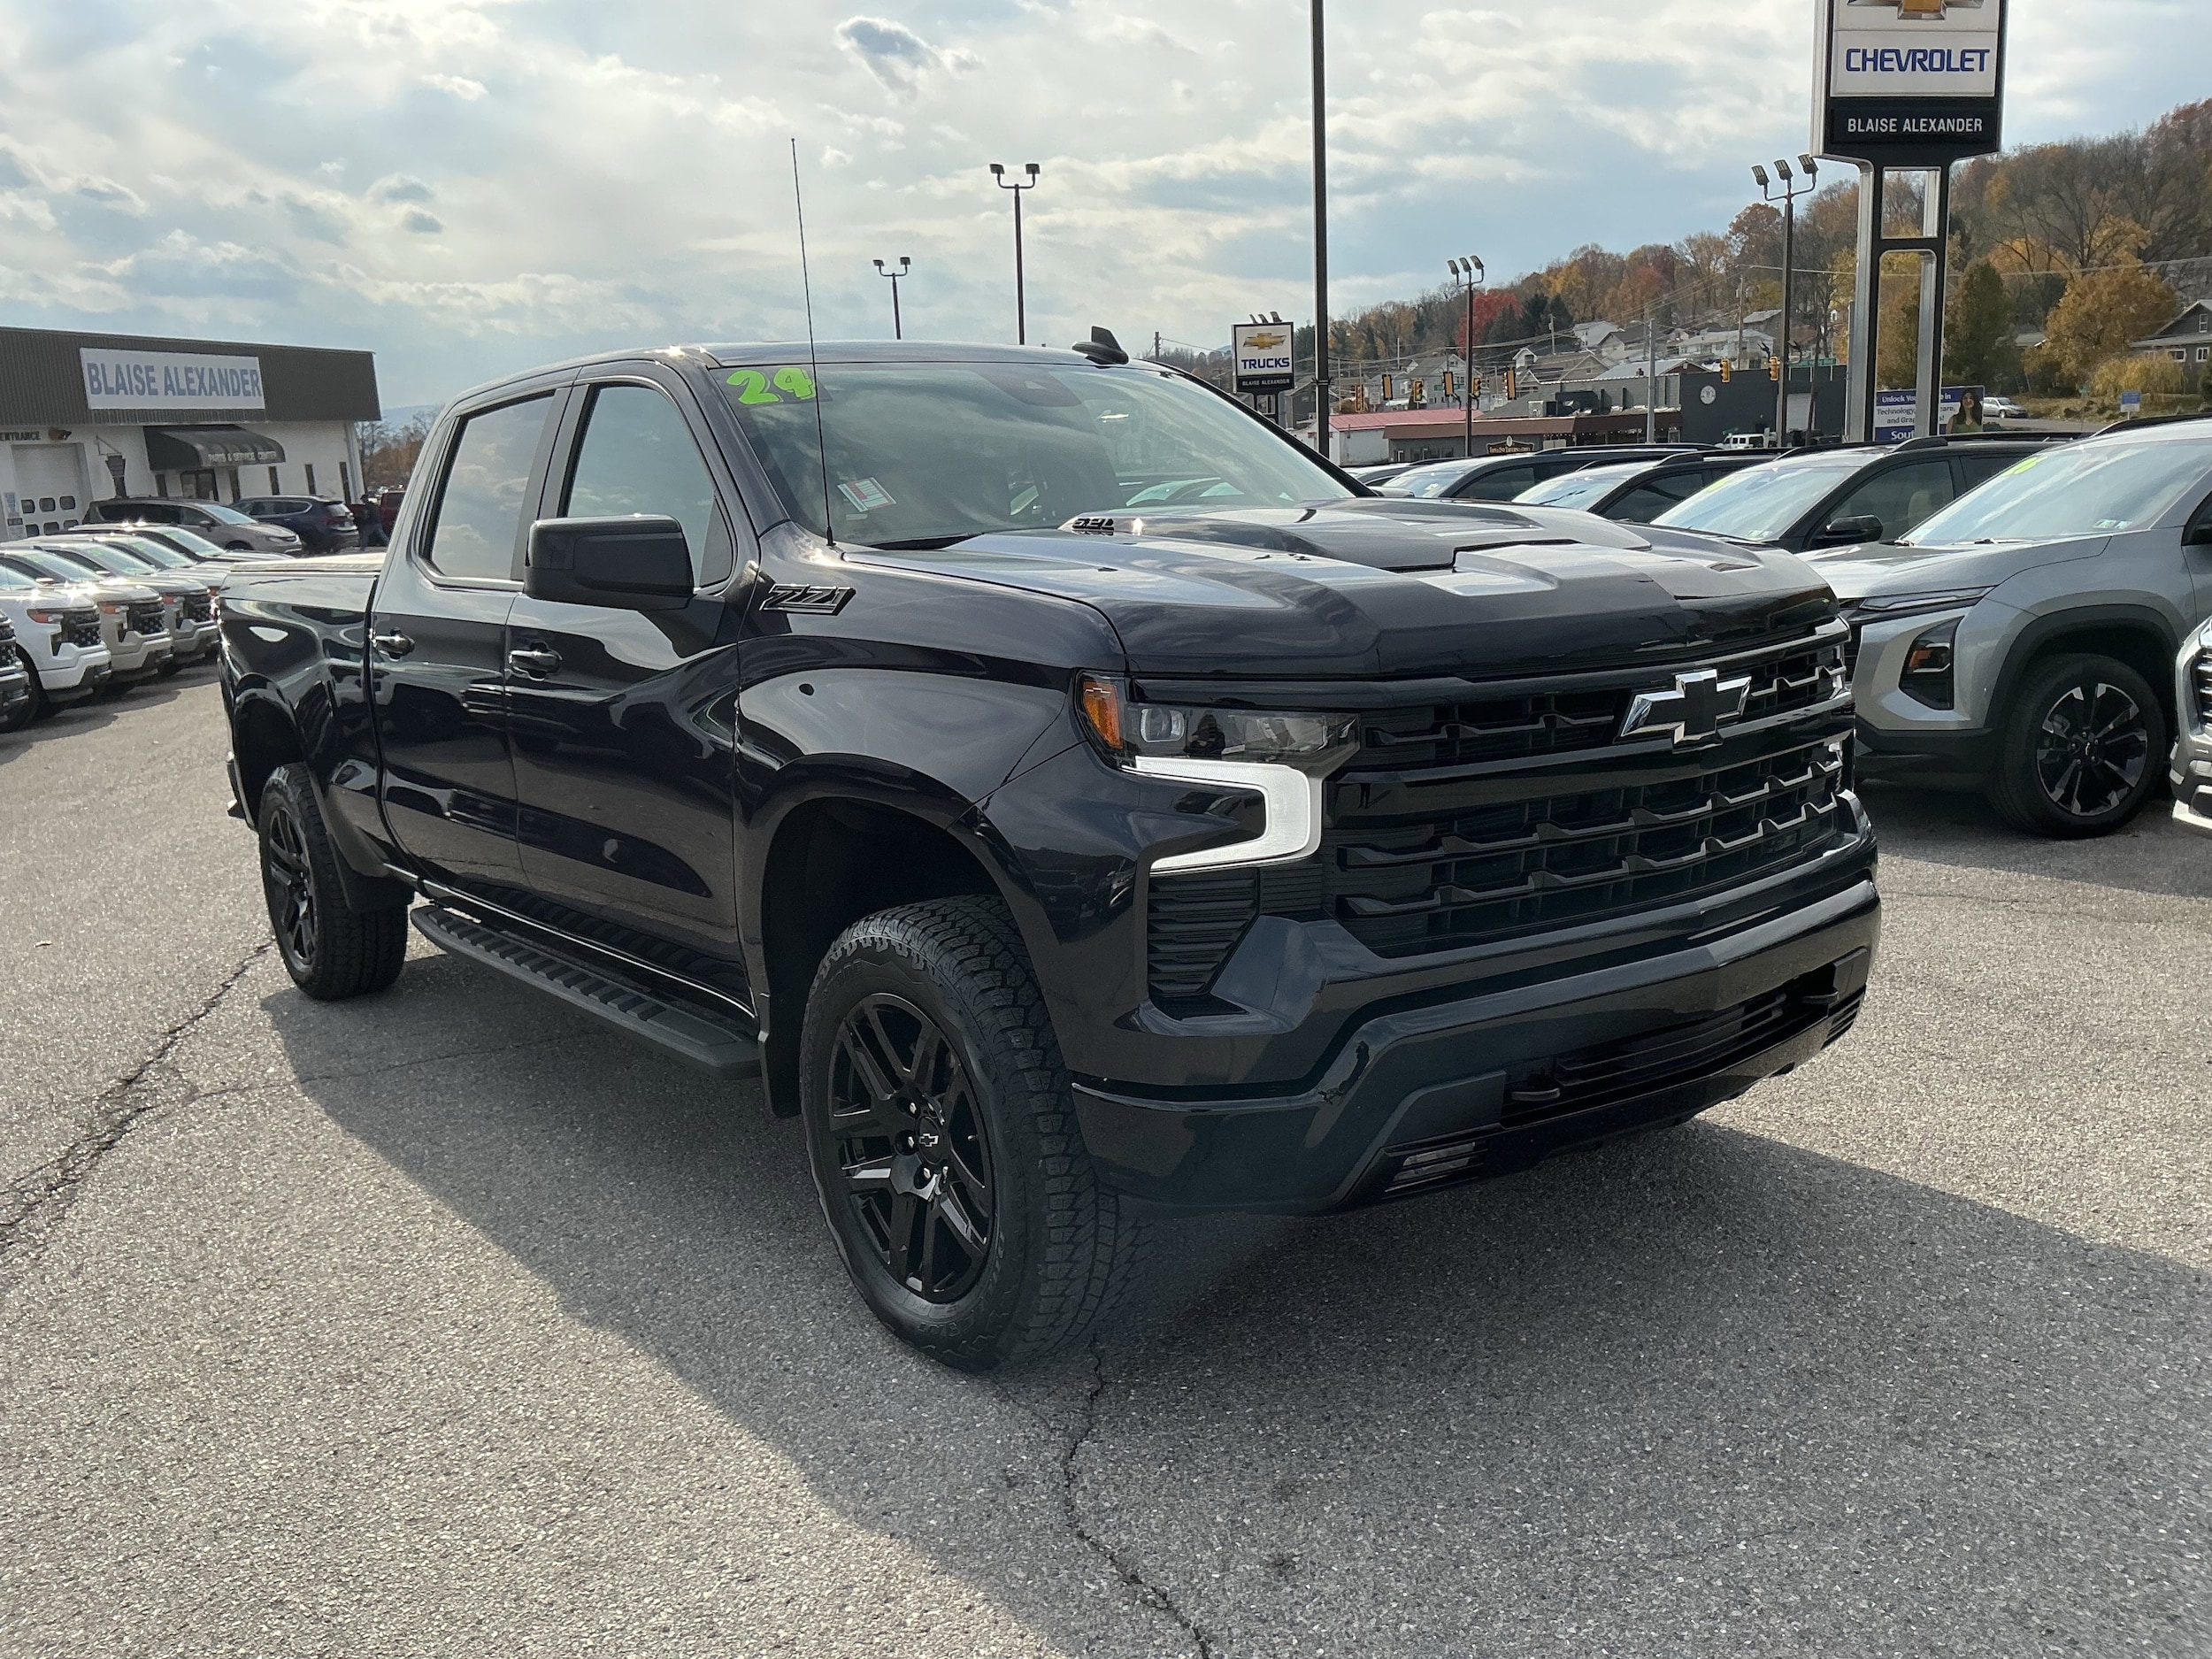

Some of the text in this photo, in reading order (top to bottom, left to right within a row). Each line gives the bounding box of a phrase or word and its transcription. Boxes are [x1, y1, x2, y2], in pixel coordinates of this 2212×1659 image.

[1846, 49, 1990, 72] CHEVROLET
[1847, 118, 1983, 133] BLAISE ALEXANDER
[1240, 357, 1290, 369] TRUCKS
[87, 363, 262, 396] BLAISE ALEXANDER
[726, 367, 816, 405] 24
[759, 583, 855, 615] Z71
